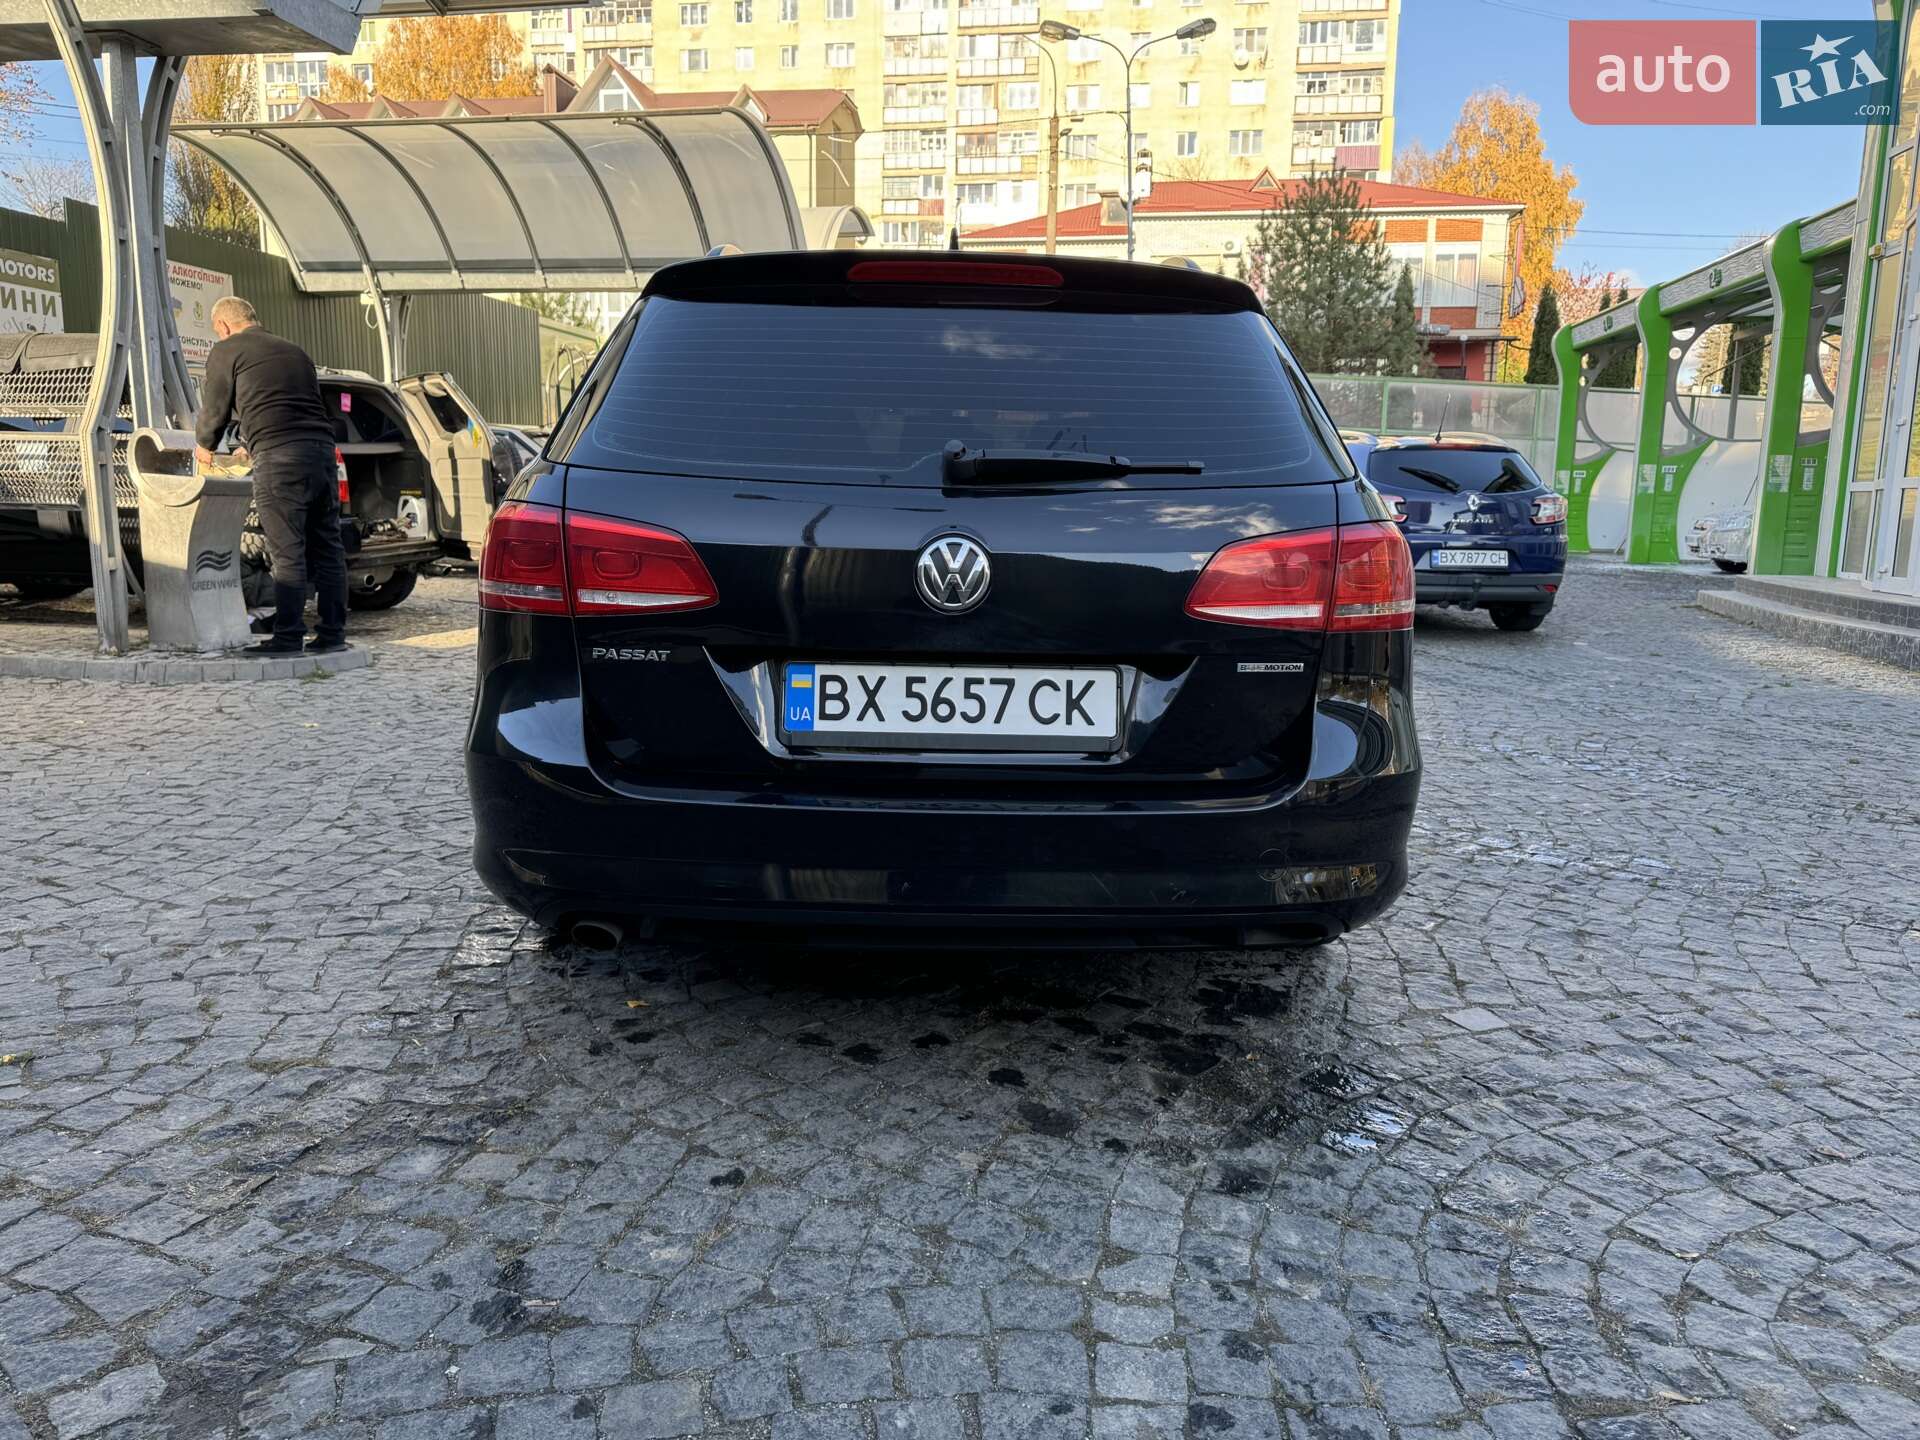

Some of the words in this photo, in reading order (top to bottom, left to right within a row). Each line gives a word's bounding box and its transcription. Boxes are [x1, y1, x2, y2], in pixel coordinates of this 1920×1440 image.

[1440, 552, 1457, 564] BX
[1459, 552, 1487, 564] 7877
[1489, 552, 1508, 564] CH
[592, 647, 671, 662] PASSAT
[818, 674, 887, 722] BX
[901, 675, 1016, 724] 5657
[1028, 678, 1096, 726] CK
[790, 706, 812, 721] UA
